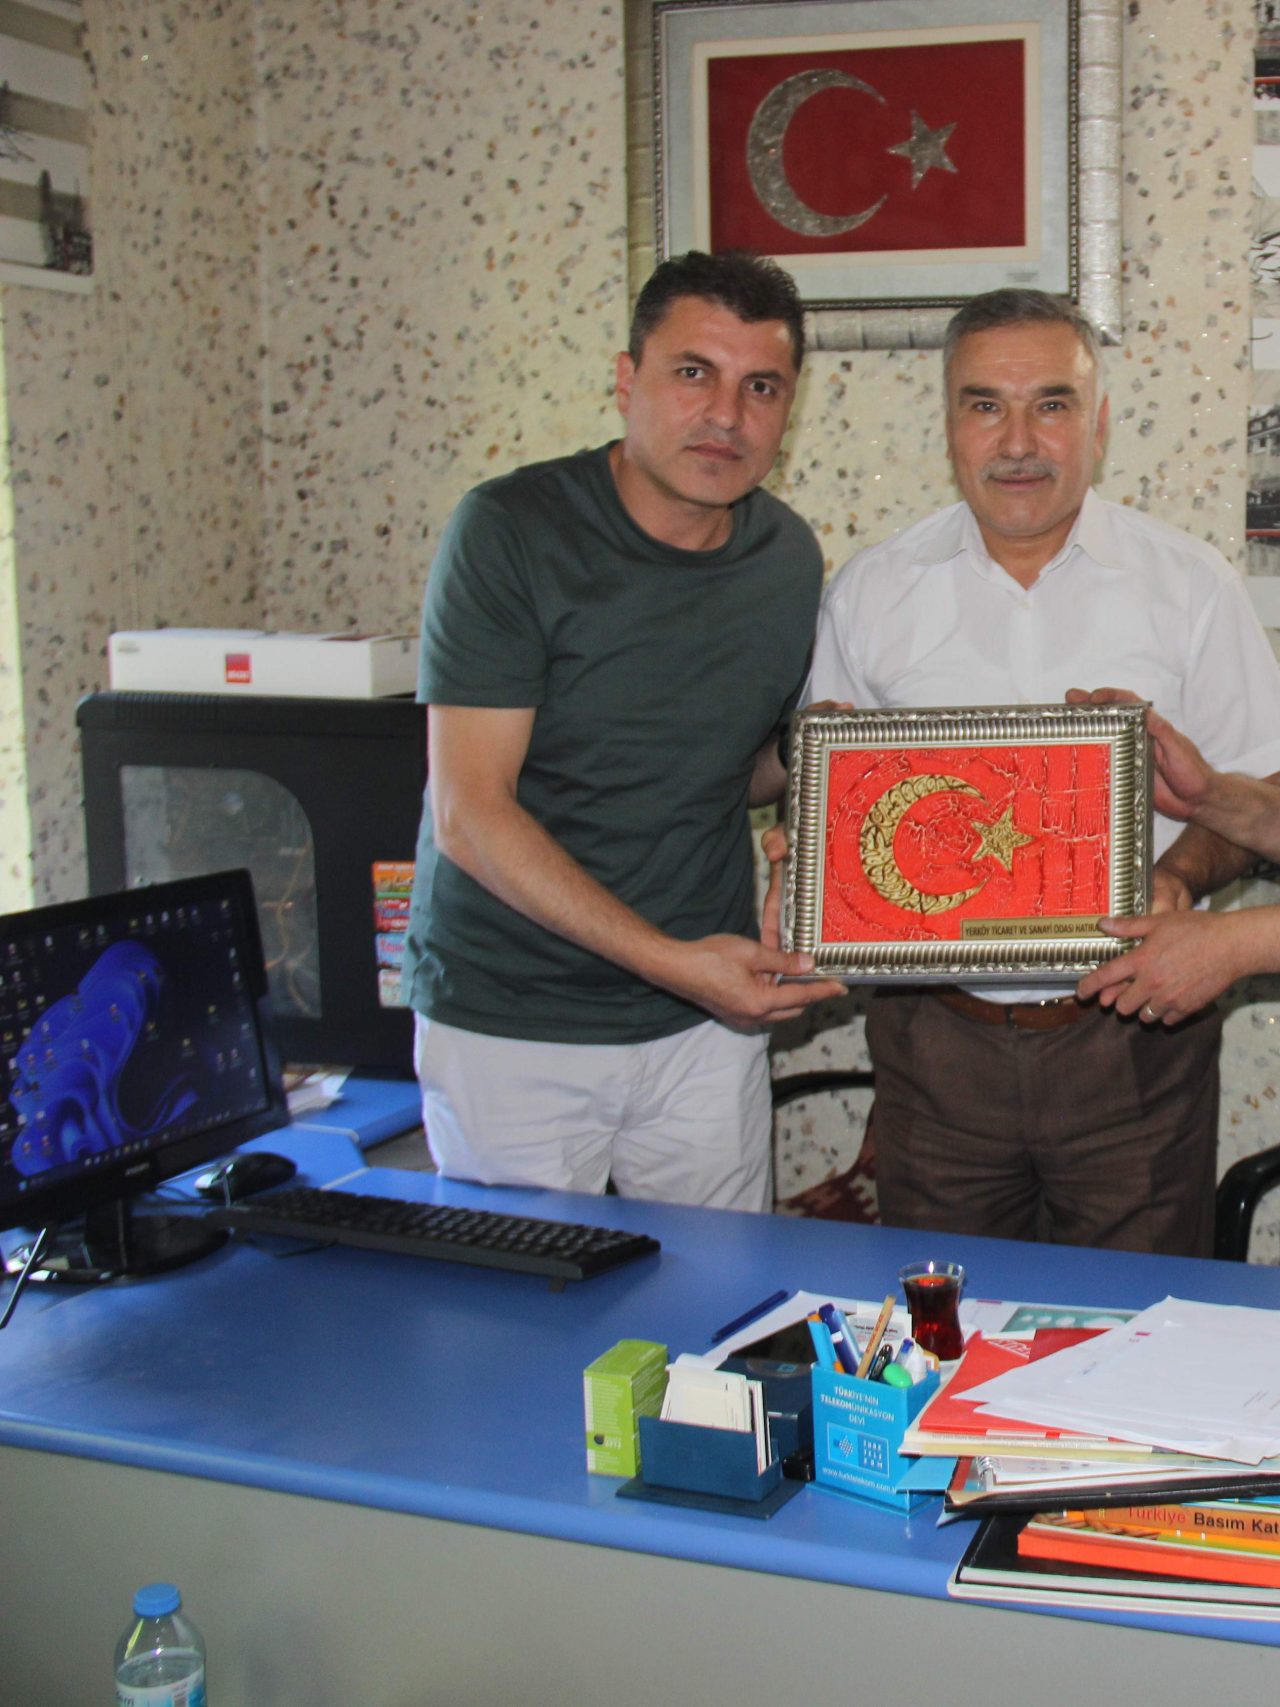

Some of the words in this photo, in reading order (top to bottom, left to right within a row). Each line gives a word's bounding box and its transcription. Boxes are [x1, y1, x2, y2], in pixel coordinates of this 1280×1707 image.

[1019, 925, 1028, 935] VE
[1075, 922, 1100, 933] HATIRA
[1194, 1512, 1245, 1531] Basım
